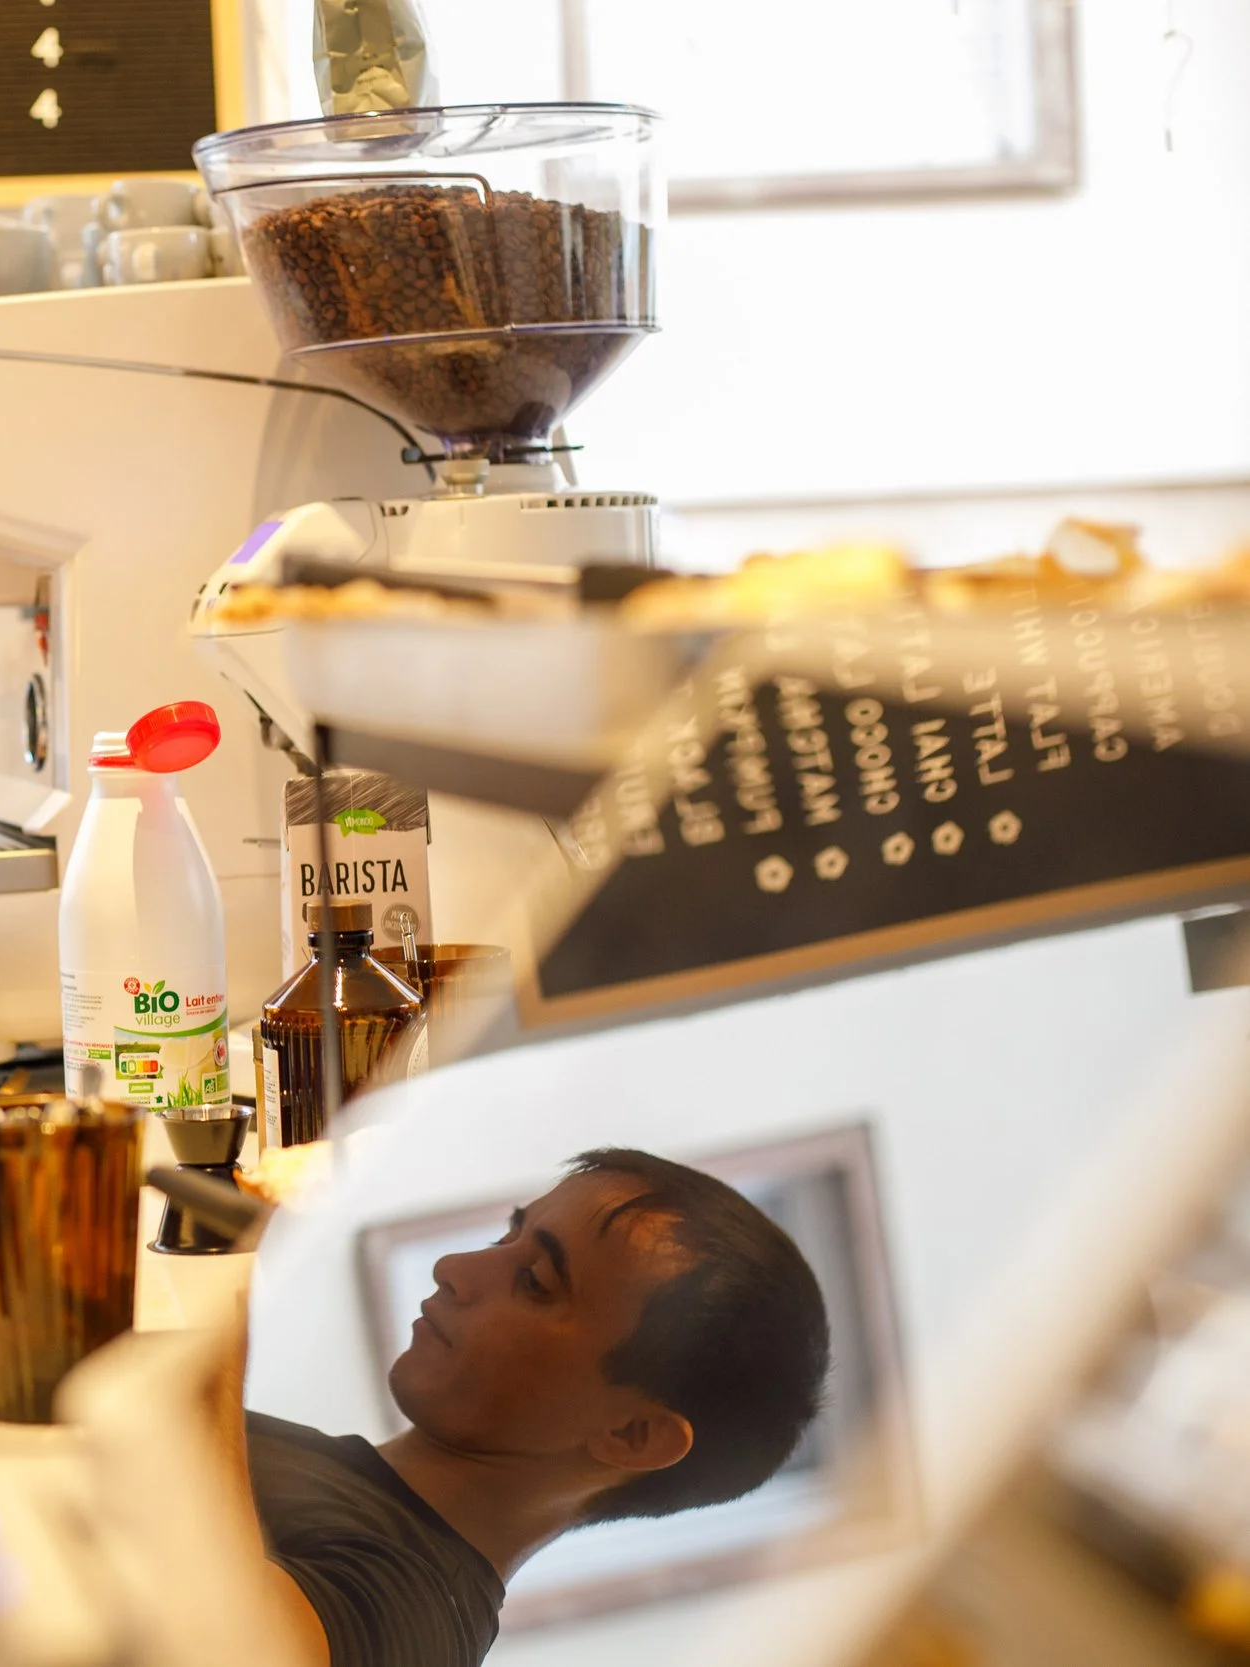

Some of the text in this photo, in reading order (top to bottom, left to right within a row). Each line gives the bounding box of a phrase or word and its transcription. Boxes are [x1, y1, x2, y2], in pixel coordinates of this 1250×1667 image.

[31, 27, 64, 68] 4
[29, 88, 62, 129] 4
[300, 859, 409, 897] BARISTA
[185, 994, 204, 1007] Lait
[135, 1014, 181, 1028] village
